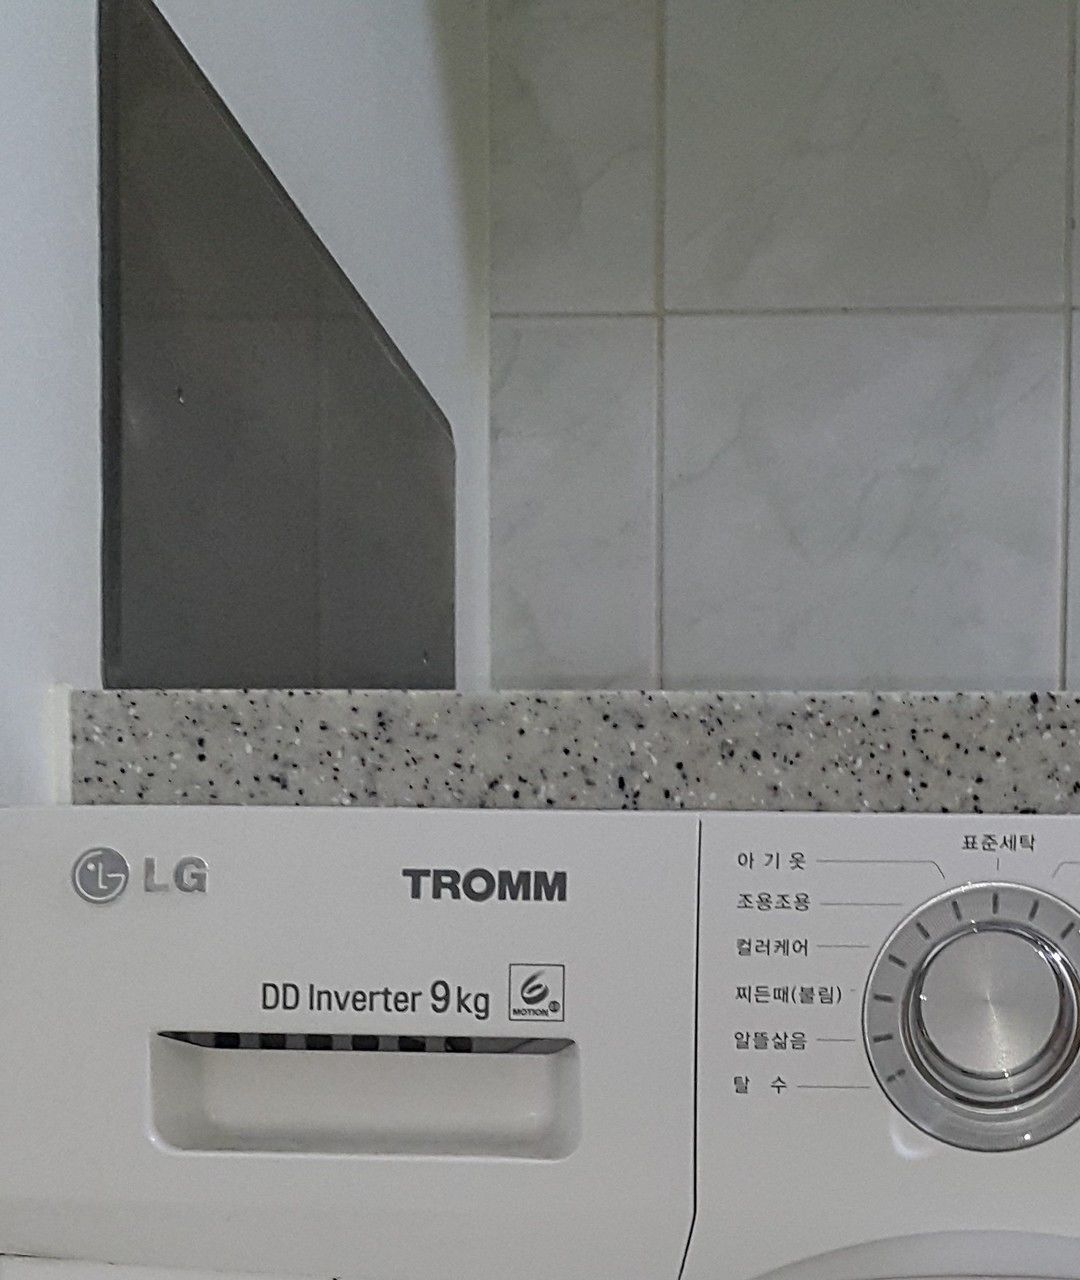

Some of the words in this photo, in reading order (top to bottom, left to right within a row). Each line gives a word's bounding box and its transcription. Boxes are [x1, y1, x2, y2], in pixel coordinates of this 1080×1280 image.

[961, 834, 1036, 854] 표준세탁
[144, 856, 207, 892] LG
[402, 867, 567, 902] TROMM
[736, 892, 811, 912] 조용조용
[736, 938, 808, 956] 컬러케어
[263, 982, 300, 1011] DD
[308, 982, 422, 1013] Inverter
[513, 1008, 549, 1017] MOTION
[734, 1031, 807, 1050] 알뜰삶음
